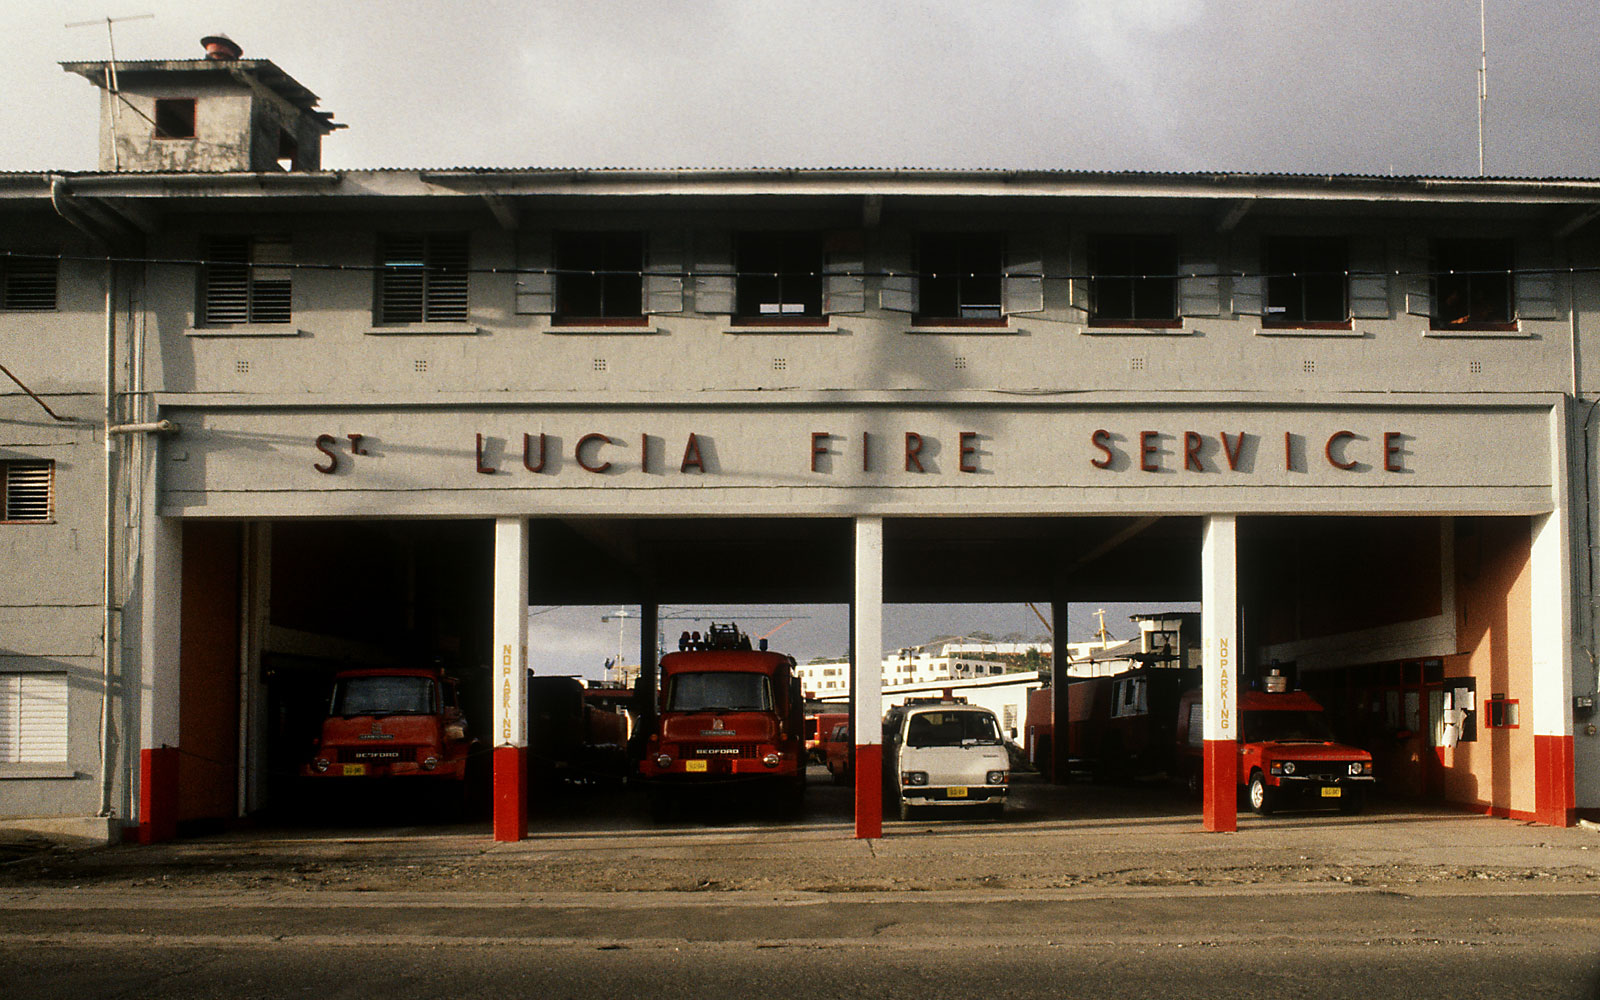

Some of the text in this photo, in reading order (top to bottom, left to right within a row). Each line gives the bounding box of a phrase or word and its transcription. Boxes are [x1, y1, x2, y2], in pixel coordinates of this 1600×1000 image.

[477, 433, 705, 474] LUCIA
[811, 432, 977, 473] FIRE
[1092, 429, 1400, 473] SERVICE
